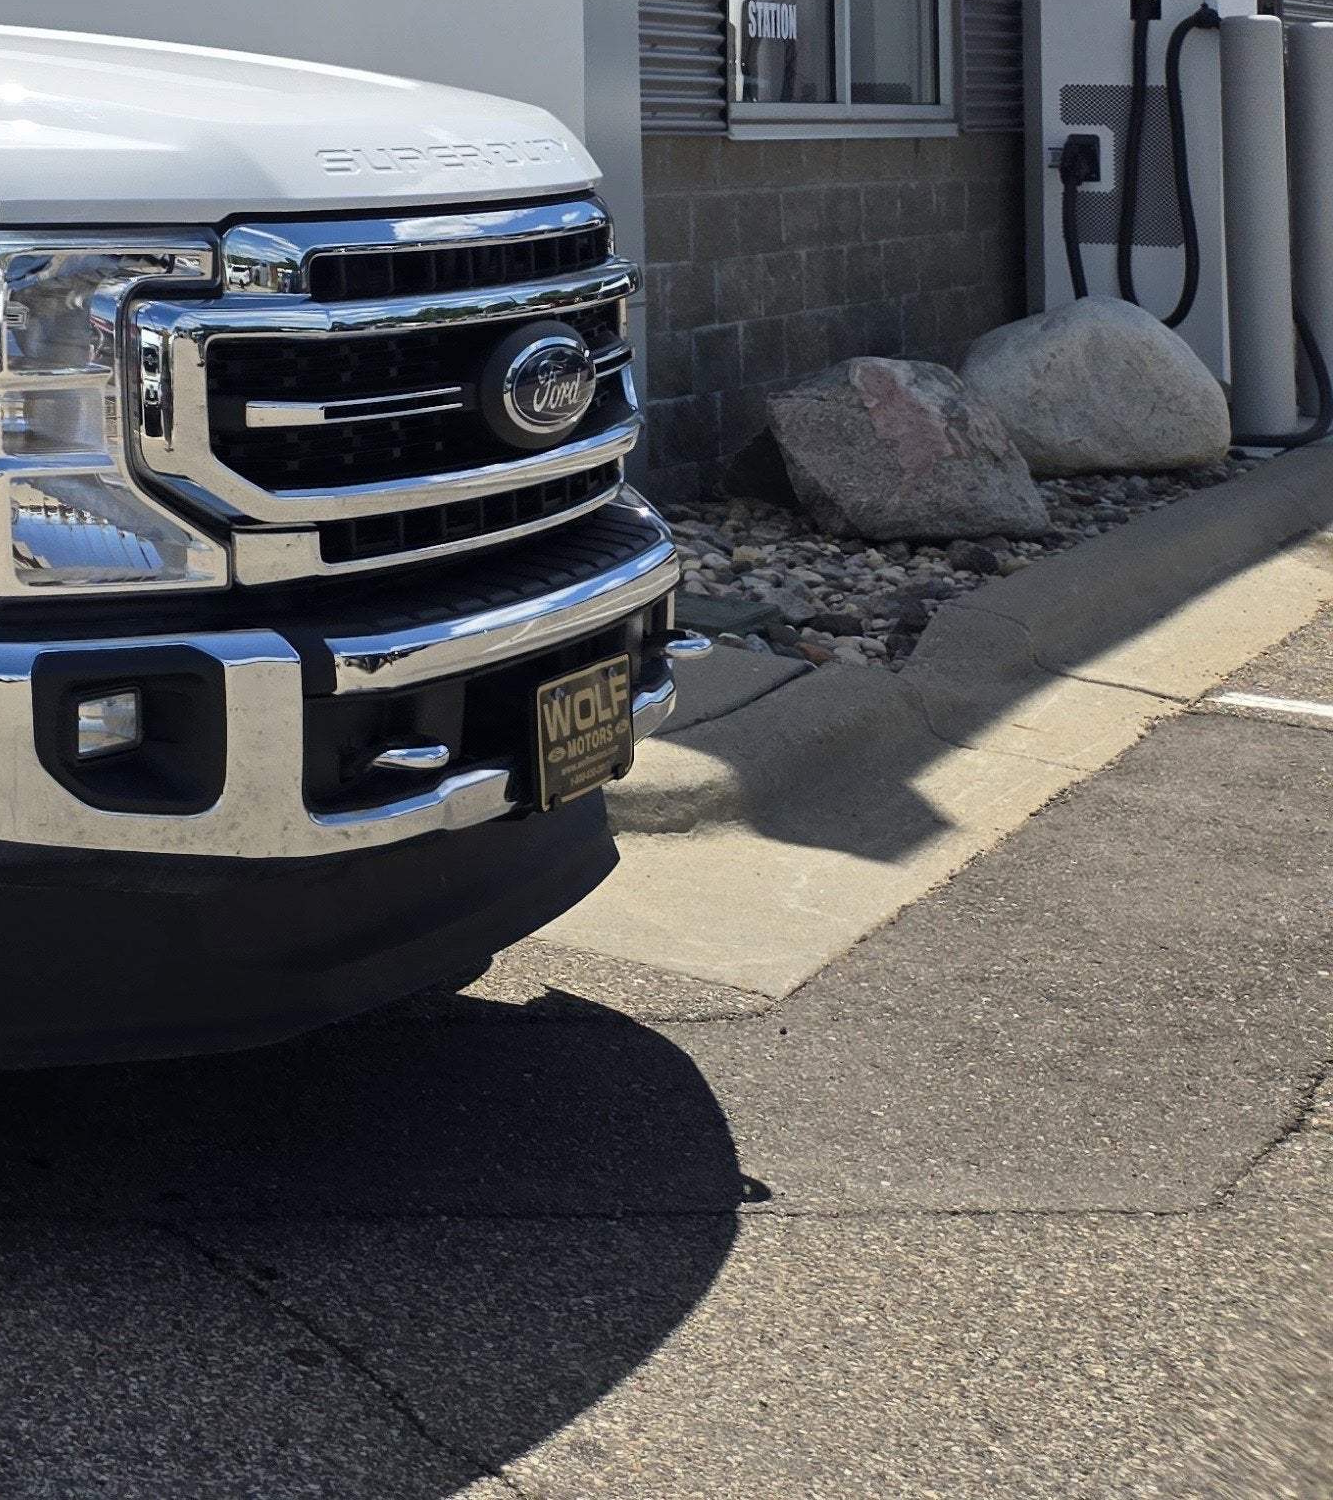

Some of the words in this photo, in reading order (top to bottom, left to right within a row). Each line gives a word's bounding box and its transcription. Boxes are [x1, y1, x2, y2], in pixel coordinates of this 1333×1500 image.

[748, 0, 797, 40] STATION
[316, 144, 495, 176] SUPER
[533, 358, 582, 412] Ford
[543, 673, 628, 742] WOLF
[567, 723, 614, 757] MOTORS
